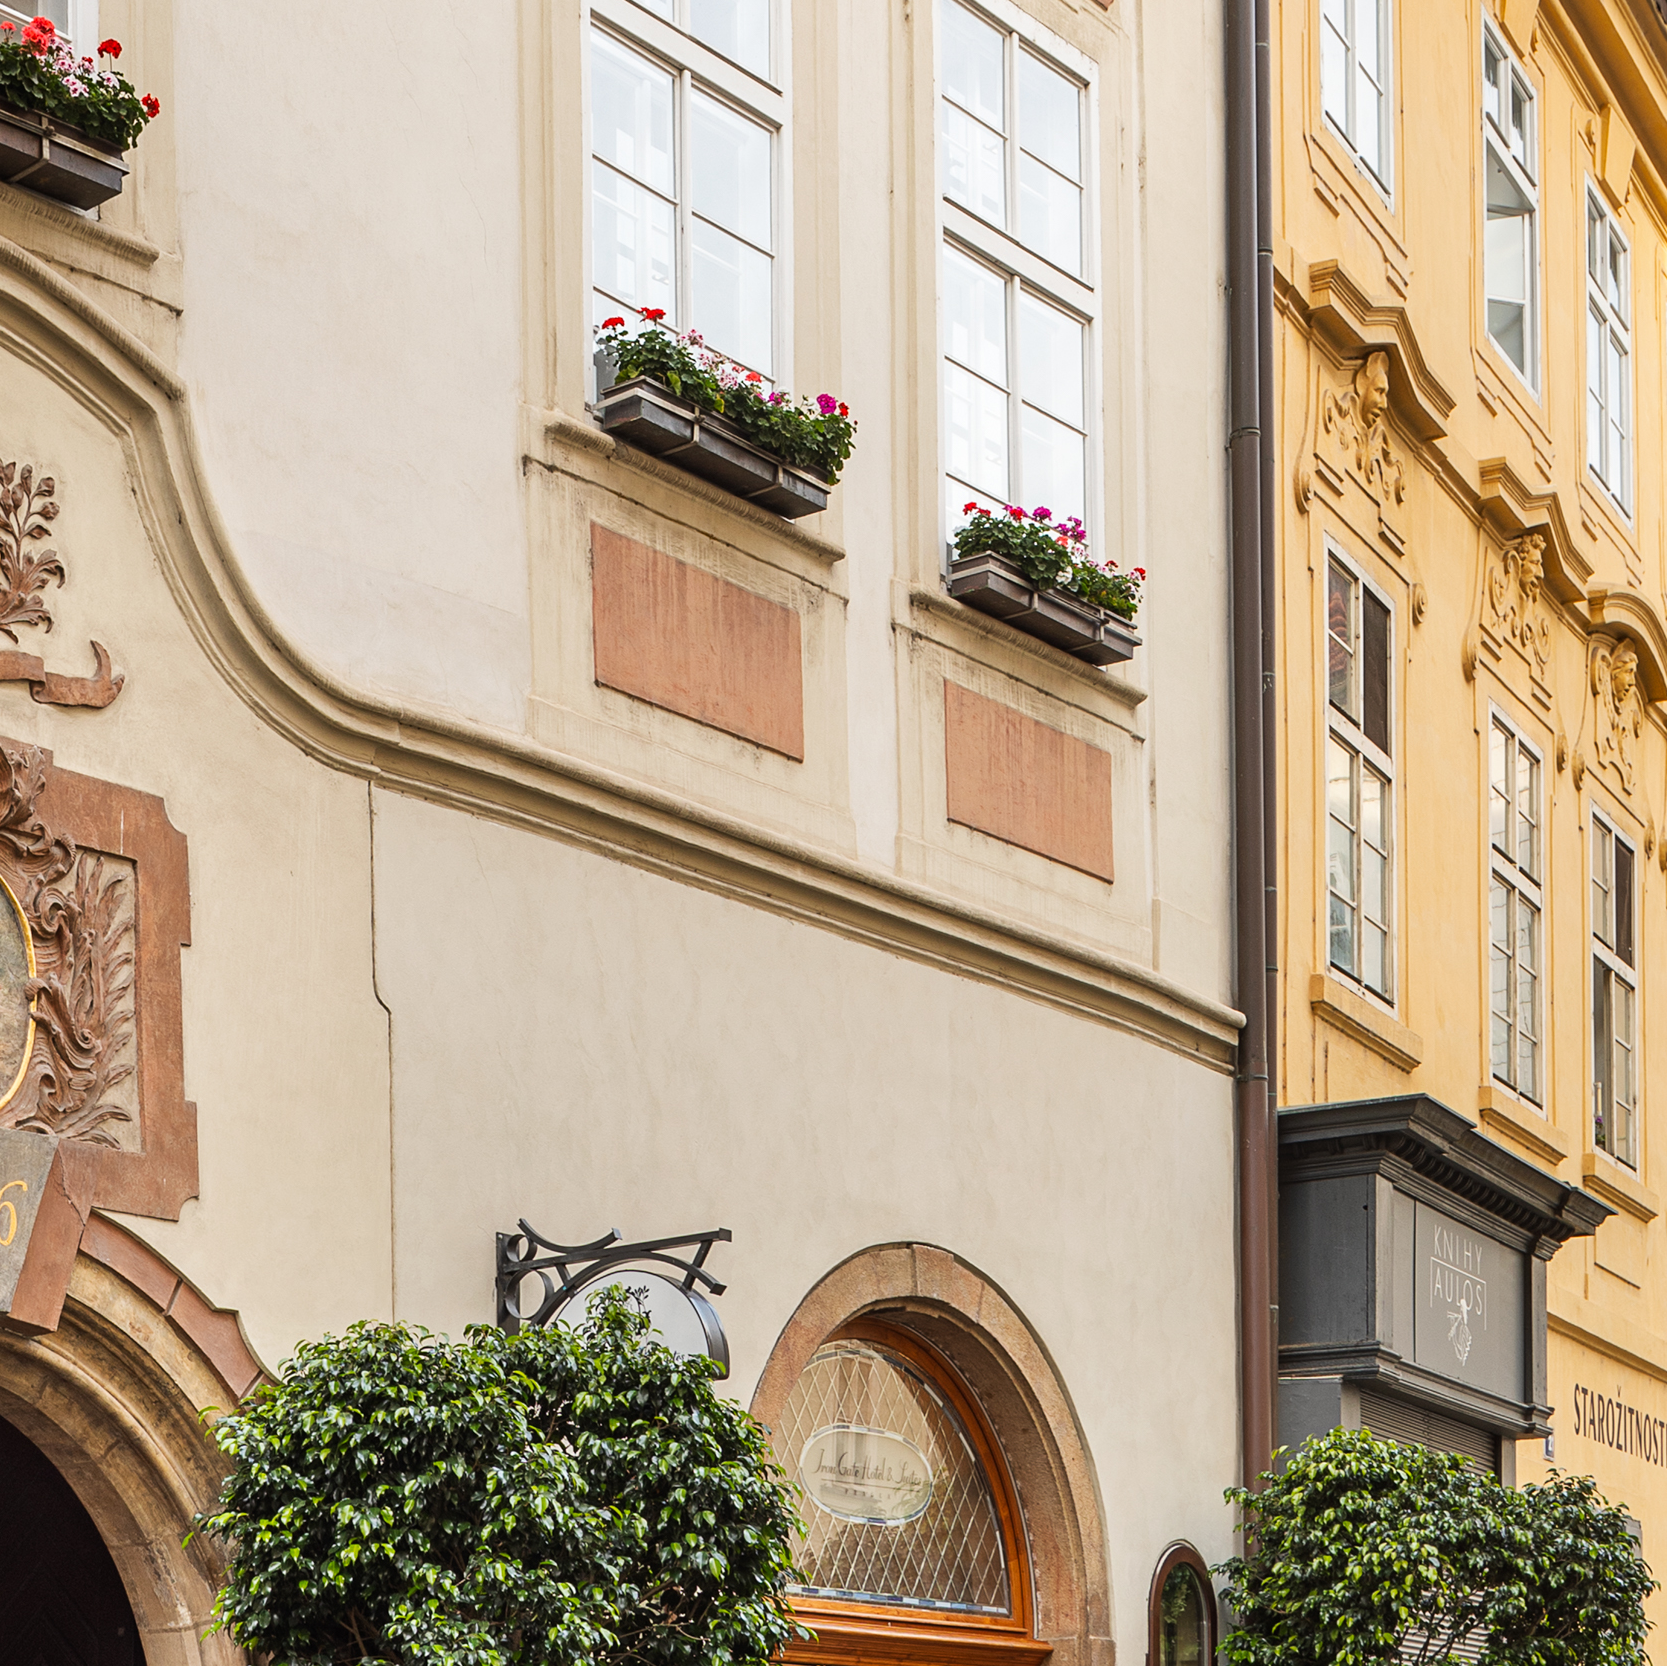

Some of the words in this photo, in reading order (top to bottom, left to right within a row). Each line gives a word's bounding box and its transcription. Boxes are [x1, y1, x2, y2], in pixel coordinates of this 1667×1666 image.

[1434, 1224, 1483, 1275] KNIHY
[1434, 1267, 1483, 1316] AULOS
[837, 1451, 860, 1478] Gate
[861, 1455, 885, 1481] Hotel
[886, 1466, 894, 1482] &
